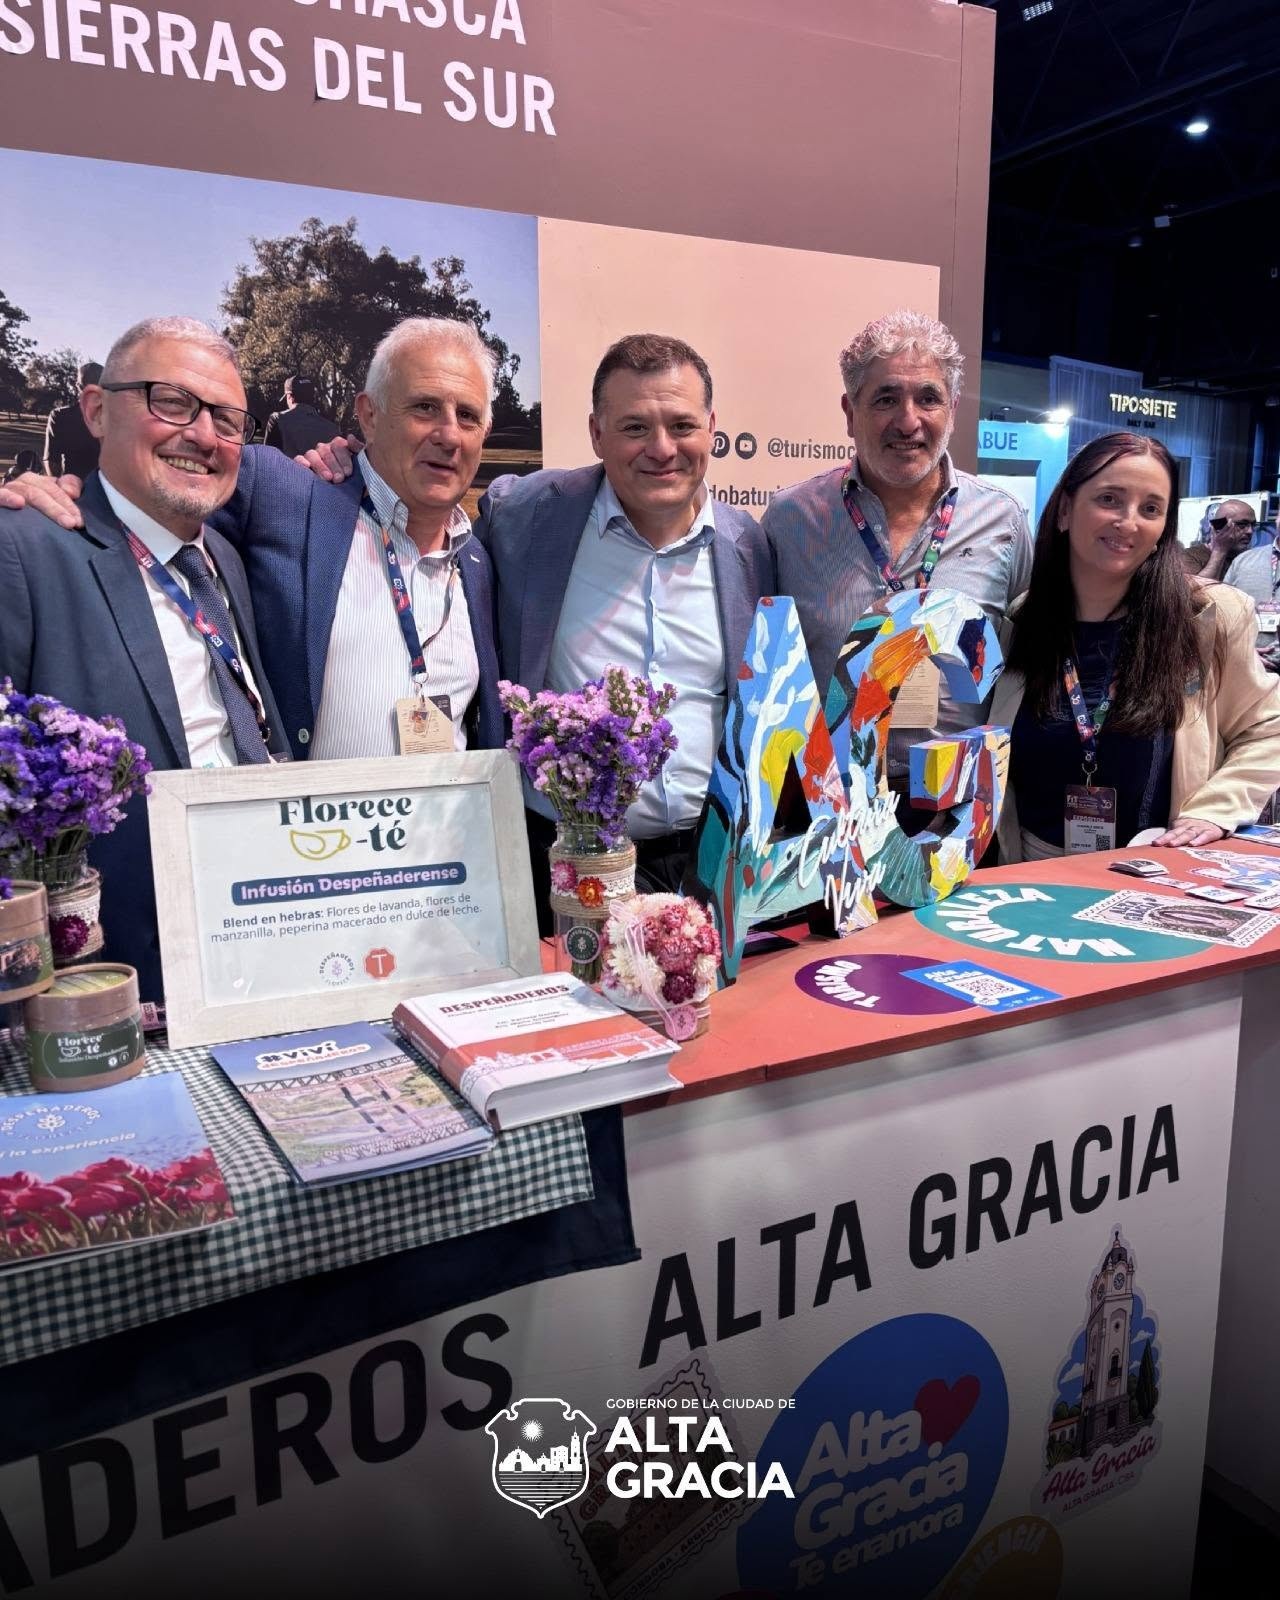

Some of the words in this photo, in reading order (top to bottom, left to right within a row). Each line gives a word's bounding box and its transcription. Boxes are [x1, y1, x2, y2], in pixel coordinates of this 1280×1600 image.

[0, 0, 287, 92] SIERRAS
[313, 36, 421, 114] DEL
[443, 61, 557, 136] SUR
[977, 431, 1018, 451] BUE
[709, 485, 780, 506] dobatur
[278, 795, 413, 826] Florece
[356, 820, 408, 852] -té
[241, 878, 315, 900] Infusión
[318, 866, 459, 893] Despeñaderense
[211, 927, 276, 943] manzanilla,
[279, 921, 329, 938] peperina
[332, 914, 387, 928] macerado
[390, 914, 403, 923] en
[406, 909, 433, 922] dulce
[436, 906, 450, 918] de
[452, 902, 483, 916] leche.
[223, 911, 258, 929] Blend
[261, 916, 277, 925] en
[280, 910, 325, 923] hebras:
[327, 906, 360, 918] Flores
[363, 904, 377, 914] de
[379, 898, 424, 913] lavanda,
[426, 894, 457, 907] flores
[459, 893, 471, 903] de
[815, 960, 880, 1007] TURISMO
[31, 1132, 136, 1154] experiencia
[639, 1200, 872, 1370] ALTA
[908, 1104, 1180, 1271] GRACIA
[794, 1410, 922, 1493] Alta
[1042, 1466, 1088, 1504] Alta
[1092, 1435, 1156, 1484] Gracia
[794, 1441, 969, 1549] Gracia
[789, 1551, 825, 1592] Te
[832, 1502, 964, 1574] enamora
